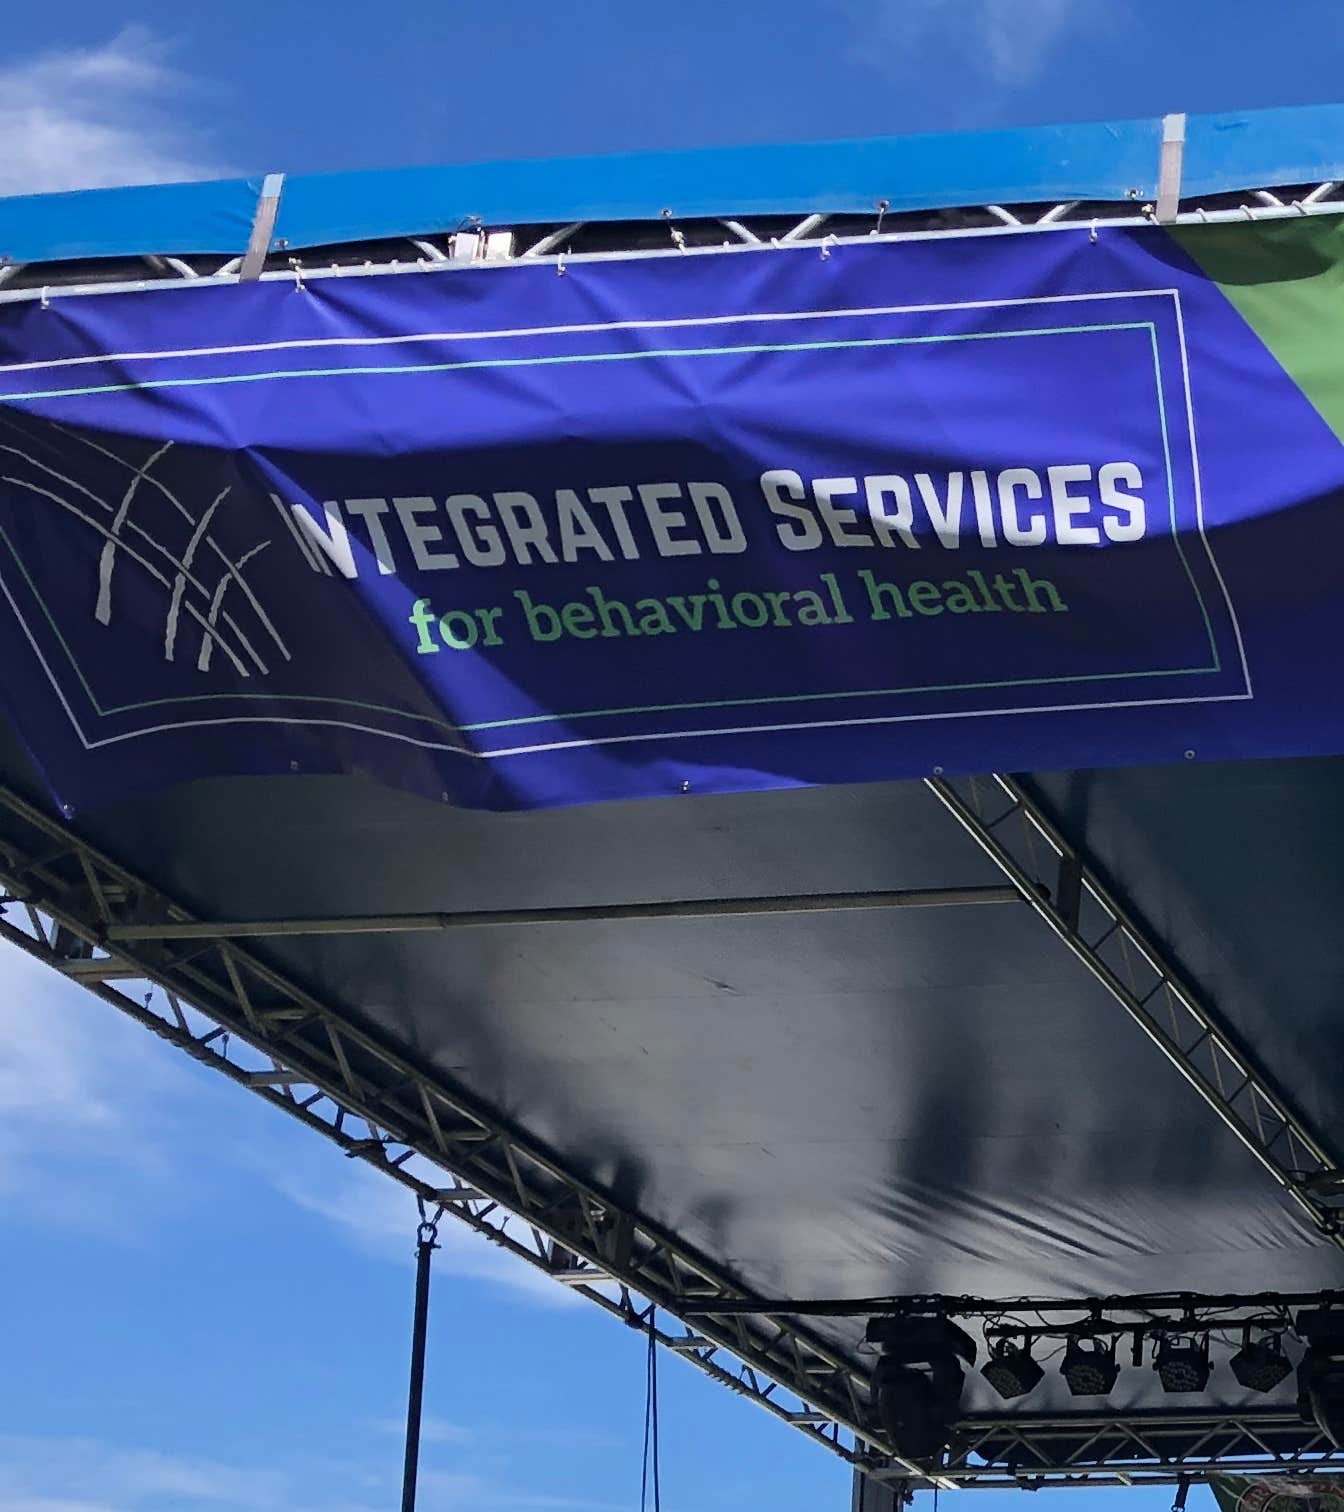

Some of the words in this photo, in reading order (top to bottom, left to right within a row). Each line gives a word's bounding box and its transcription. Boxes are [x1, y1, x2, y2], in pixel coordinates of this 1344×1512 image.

[409, 597, 505, 654] for
[514, 572, 853, 642] behavioral
[857, 566, 1069, 621] health
